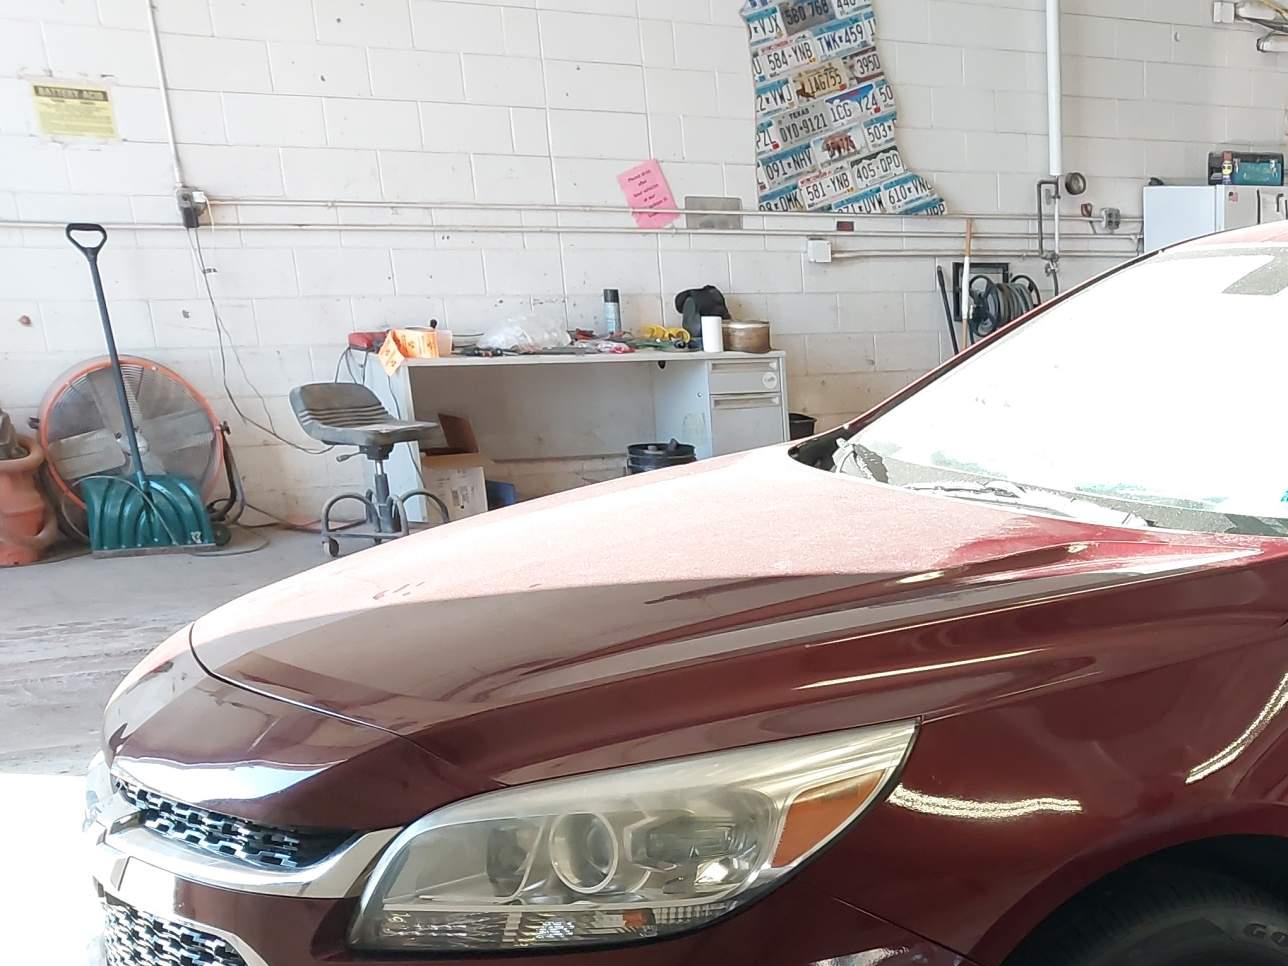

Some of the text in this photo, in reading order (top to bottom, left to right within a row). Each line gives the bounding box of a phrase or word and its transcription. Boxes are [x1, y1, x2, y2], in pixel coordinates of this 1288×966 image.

[767, 41, 813, 71] 584-YNB
[789, 108, 810, 120] TEXAS
[806, 172, 850, 201] 581-YNB
